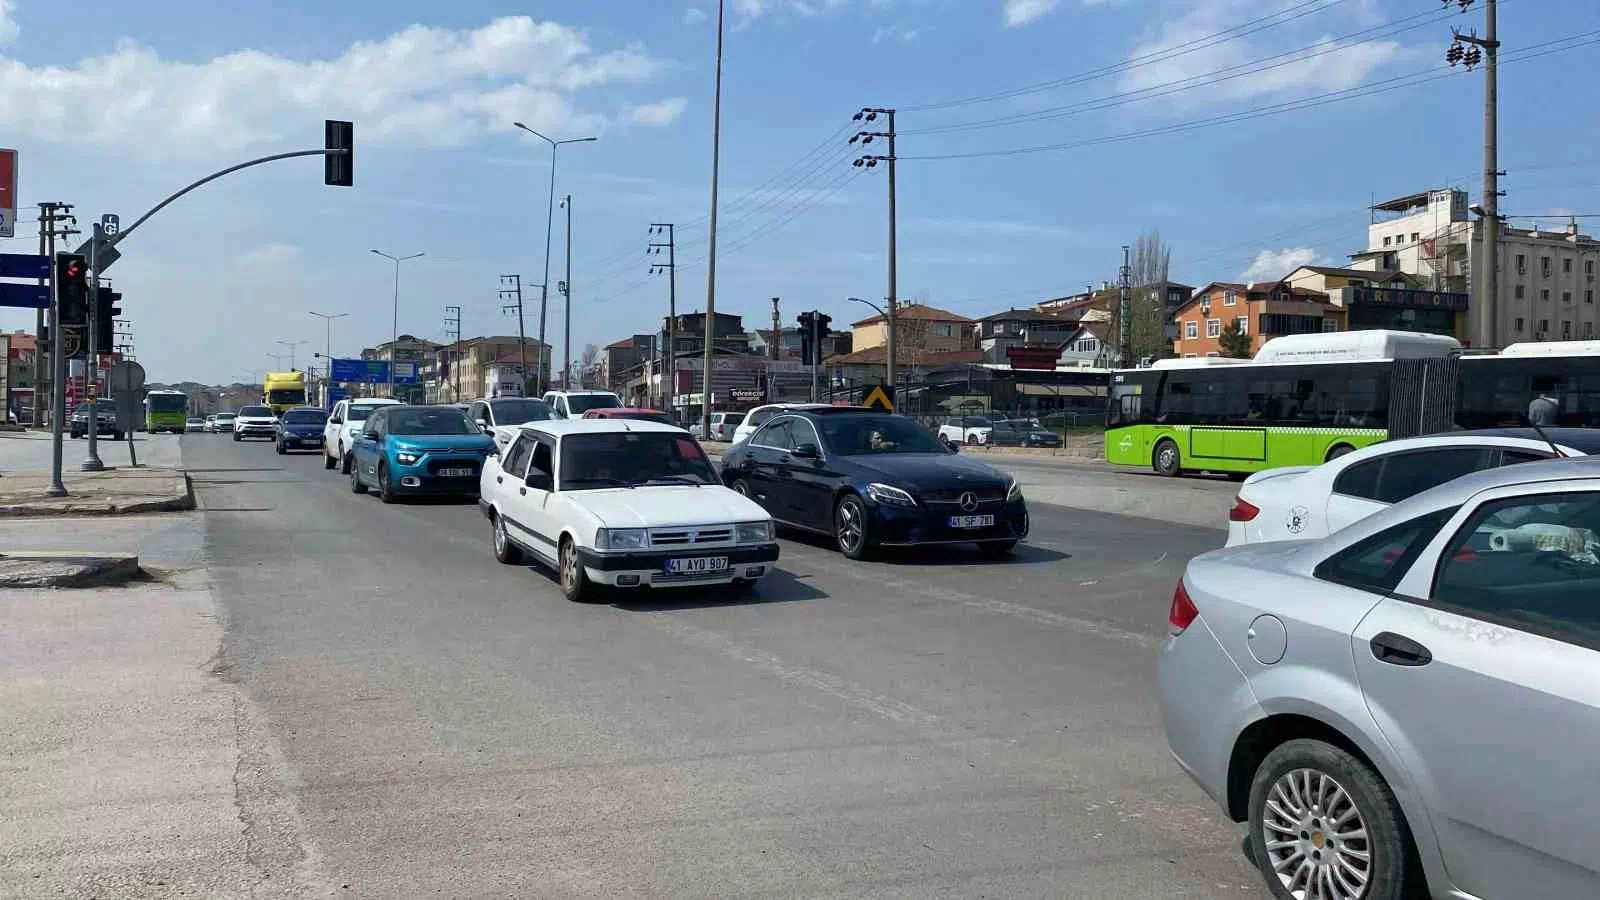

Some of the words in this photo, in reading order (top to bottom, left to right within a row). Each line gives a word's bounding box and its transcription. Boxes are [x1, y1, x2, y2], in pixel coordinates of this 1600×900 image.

[672, 560, 680, 571] 41
[688, 559, 705, 570] AYD
[711, 558, 728, 569] 907
